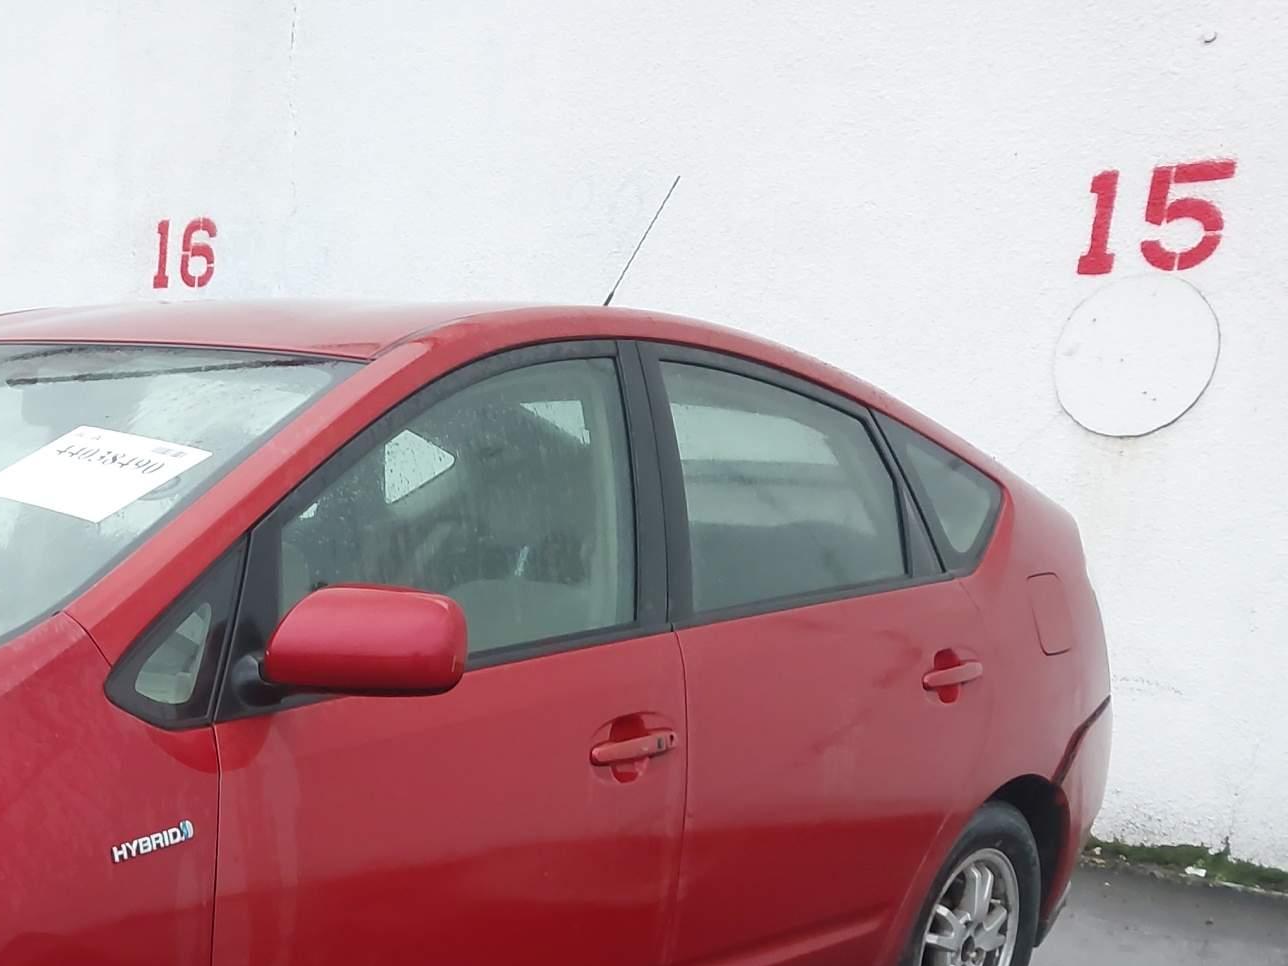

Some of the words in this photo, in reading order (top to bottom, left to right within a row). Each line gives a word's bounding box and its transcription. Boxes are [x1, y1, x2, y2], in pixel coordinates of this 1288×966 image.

[152, 217, 217, 289] 16
[1076, 158, 1238, 276] 15
[111, 826, 186, 863] HYBRID
